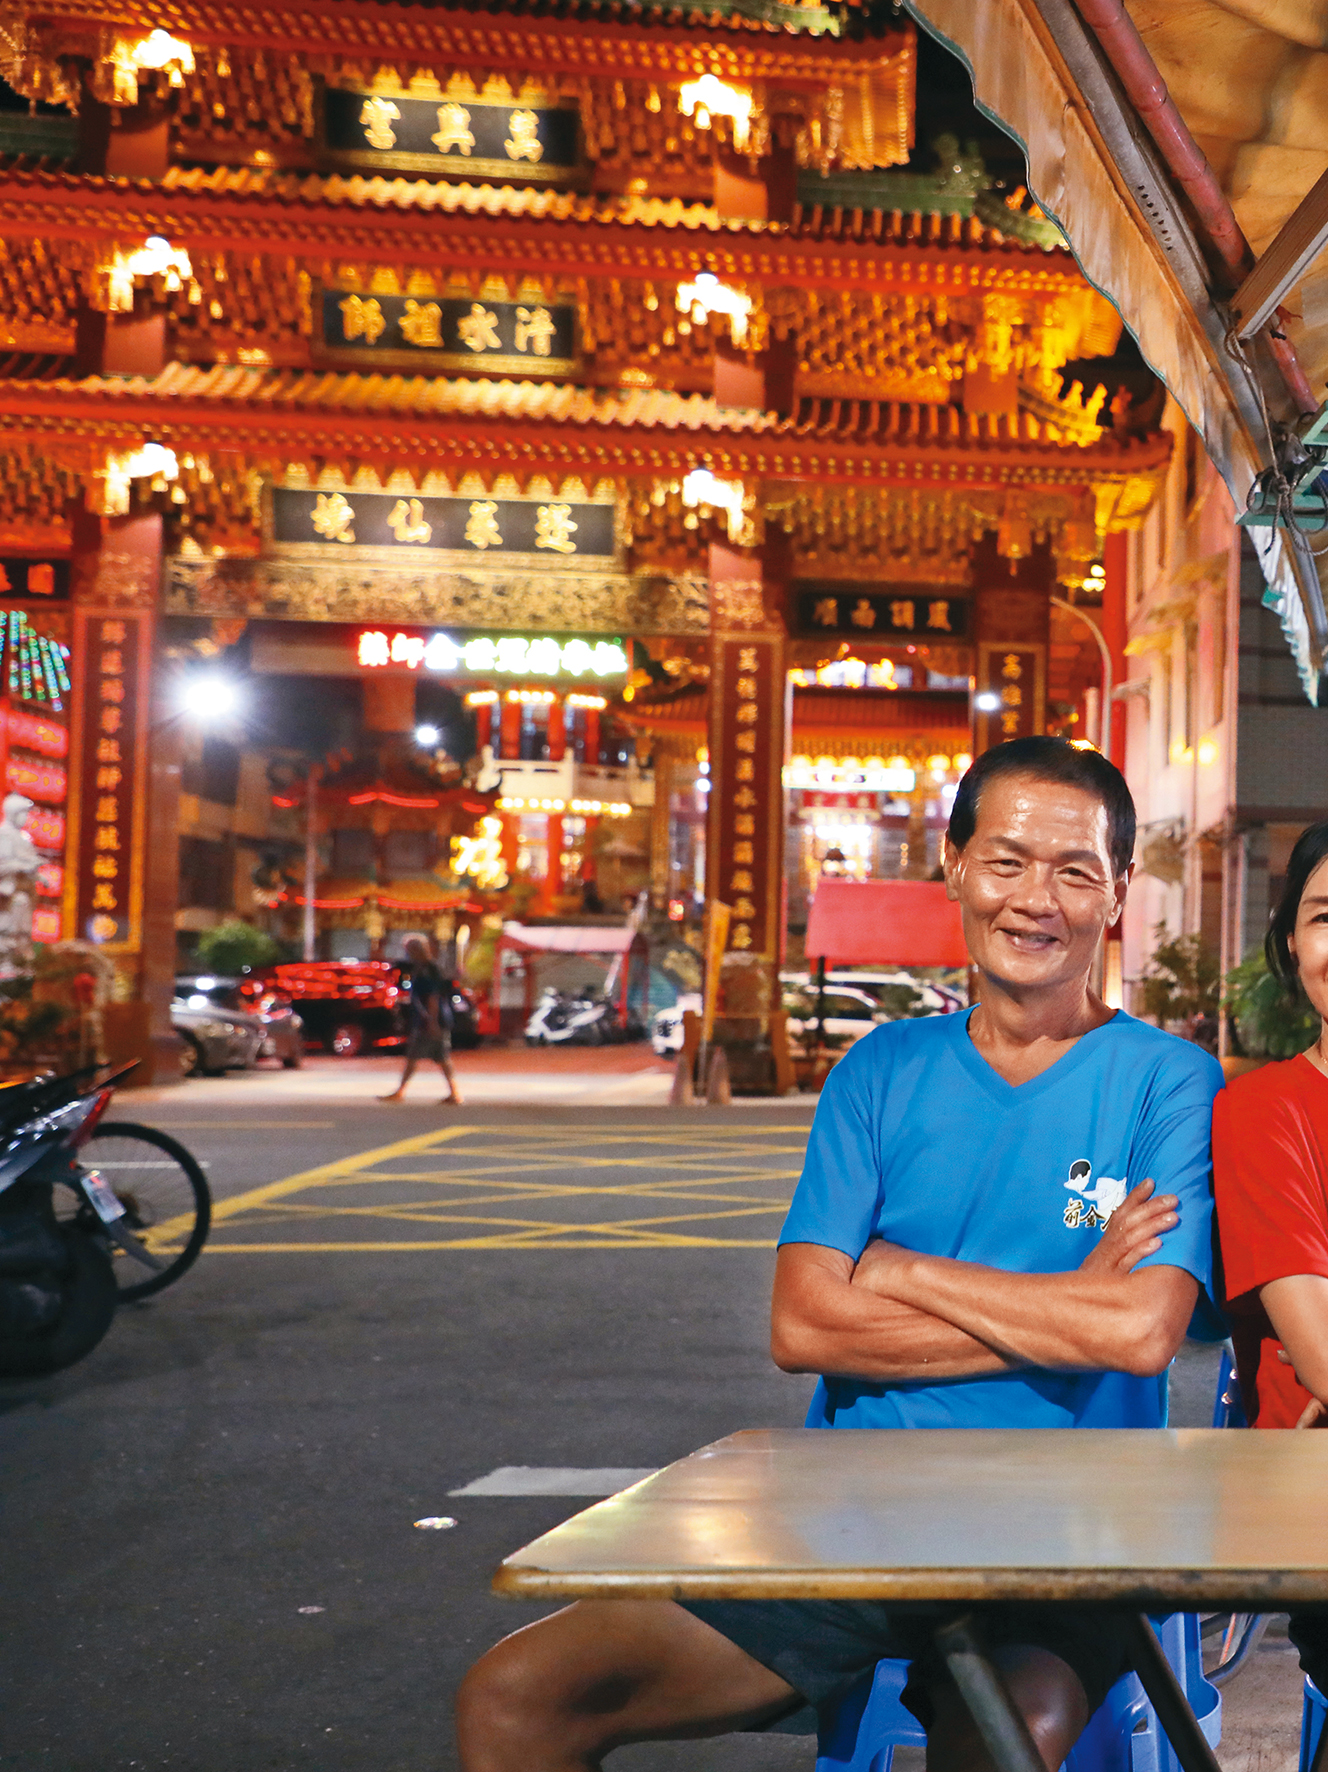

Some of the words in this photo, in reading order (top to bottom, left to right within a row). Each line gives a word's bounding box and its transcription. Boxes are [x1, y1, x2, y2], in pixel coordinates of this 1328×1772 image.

[338, 294, 557, 357] 清水祖師
[1064, 1198, 1114, 1231] 前金
